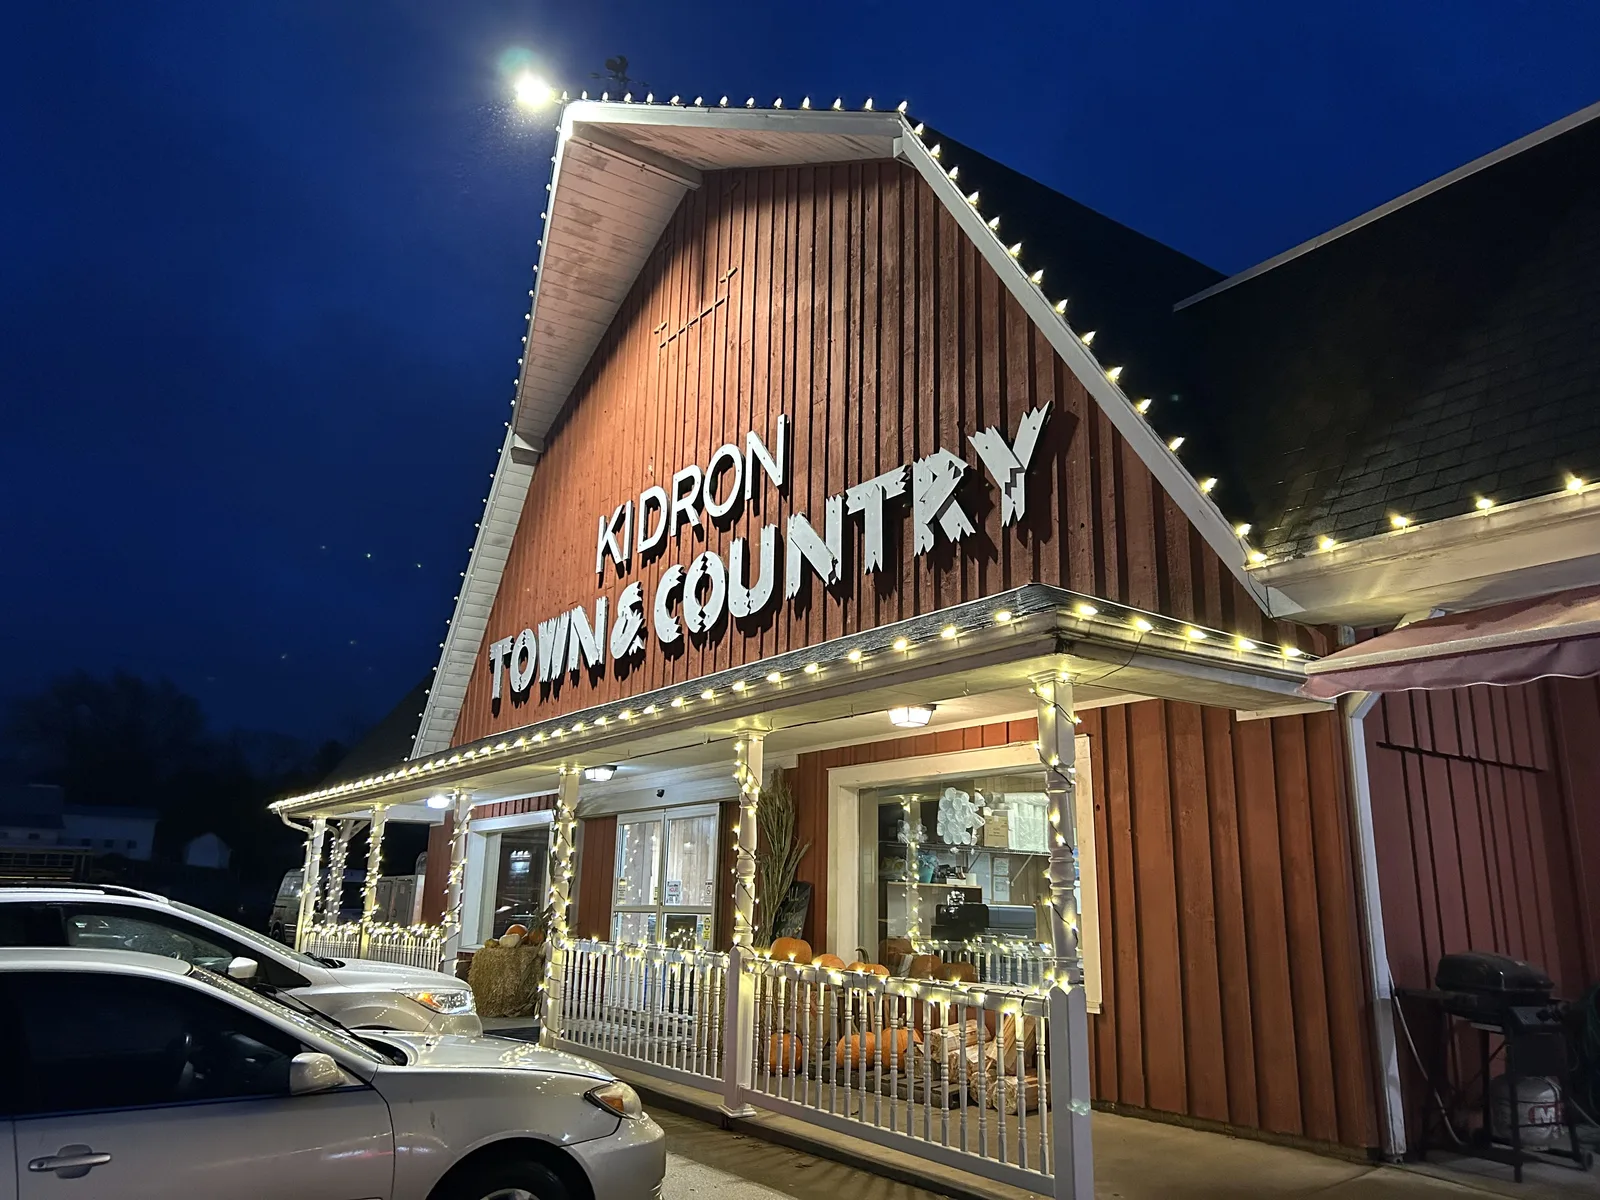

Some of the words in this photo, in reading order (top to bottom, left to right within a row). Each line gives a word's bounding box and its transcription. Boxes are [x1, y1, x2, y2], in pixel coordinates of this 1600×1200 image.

[489, 596, 608, 700] TOWN
[610, 581, 646, 660] &
[654, 400, 1051, 644] COUNTRY
[595, 412, 791, 573] KIDRON
